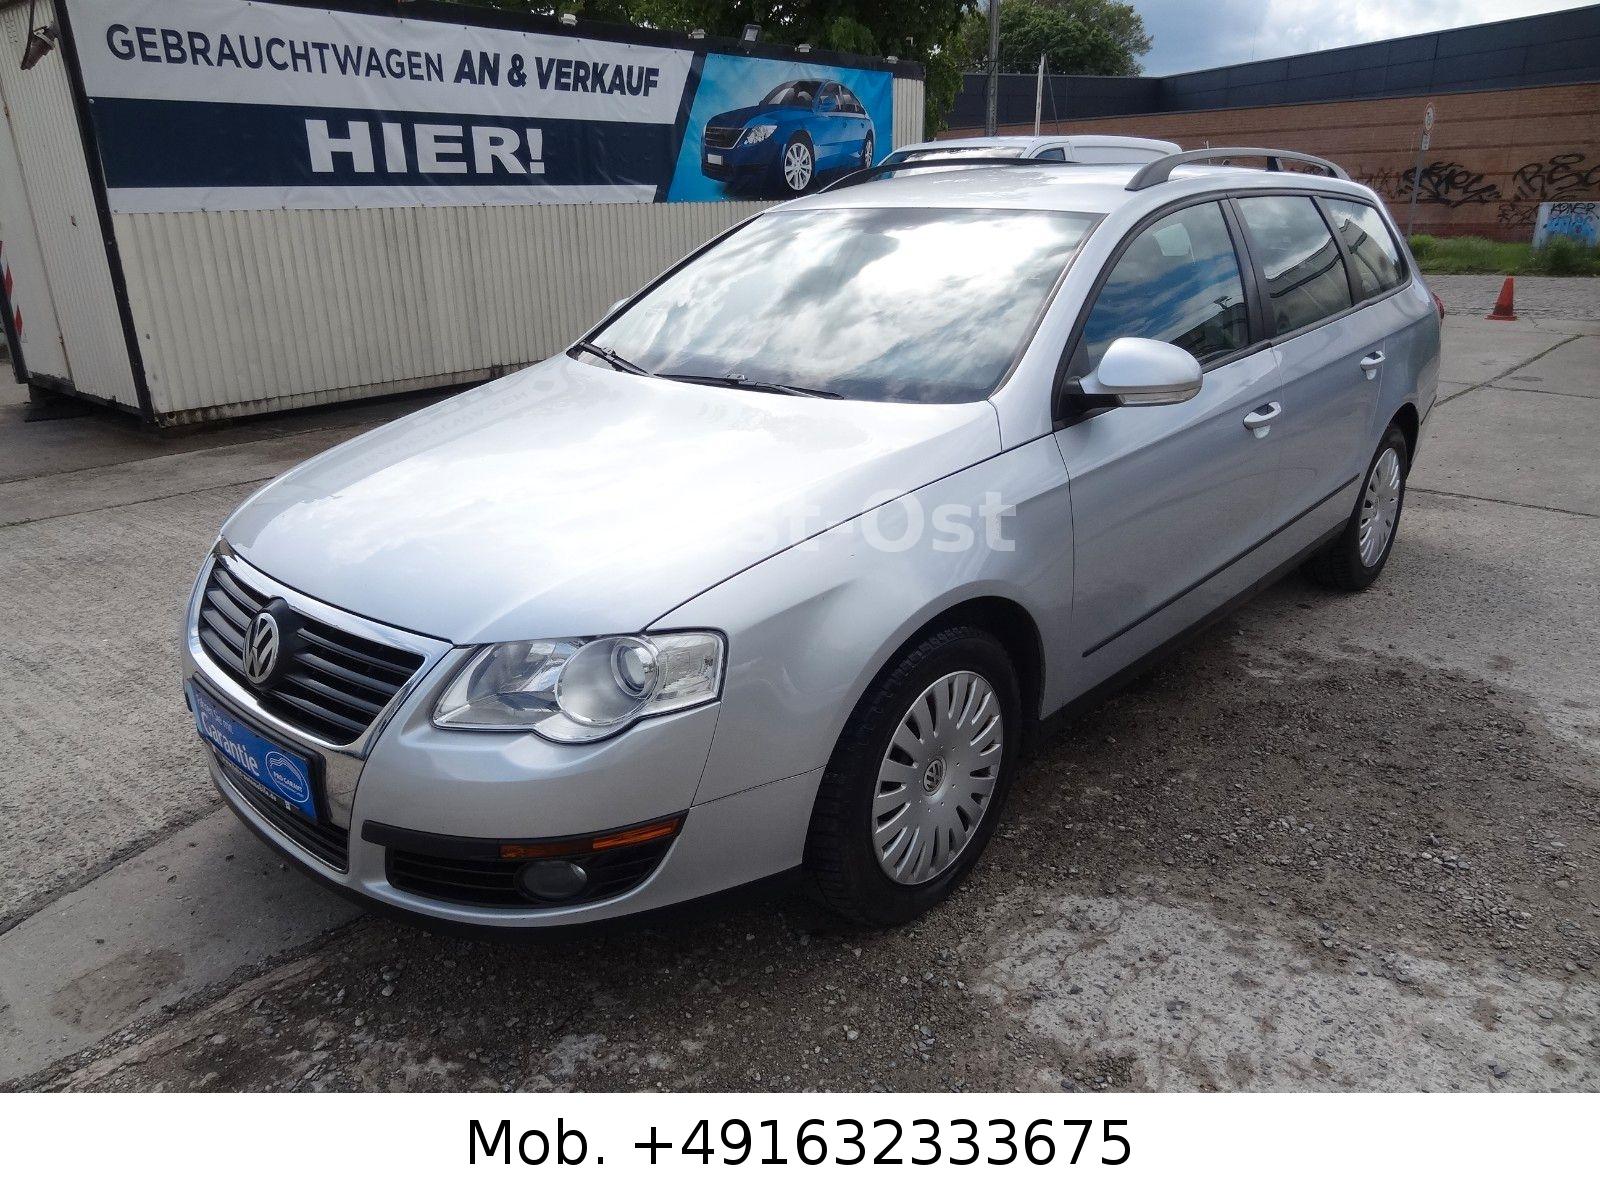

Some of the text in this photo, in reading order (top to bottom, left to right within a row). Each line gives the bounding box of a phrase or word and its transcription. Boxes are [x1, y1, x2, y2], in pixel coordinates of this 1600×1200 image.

[106, 24, 659, 97] GEBRAUCHTWAGEN AN & VERKAUF
[305, 119, 545, 174] HIER!
[201, 711, 260, 777] Garantie
